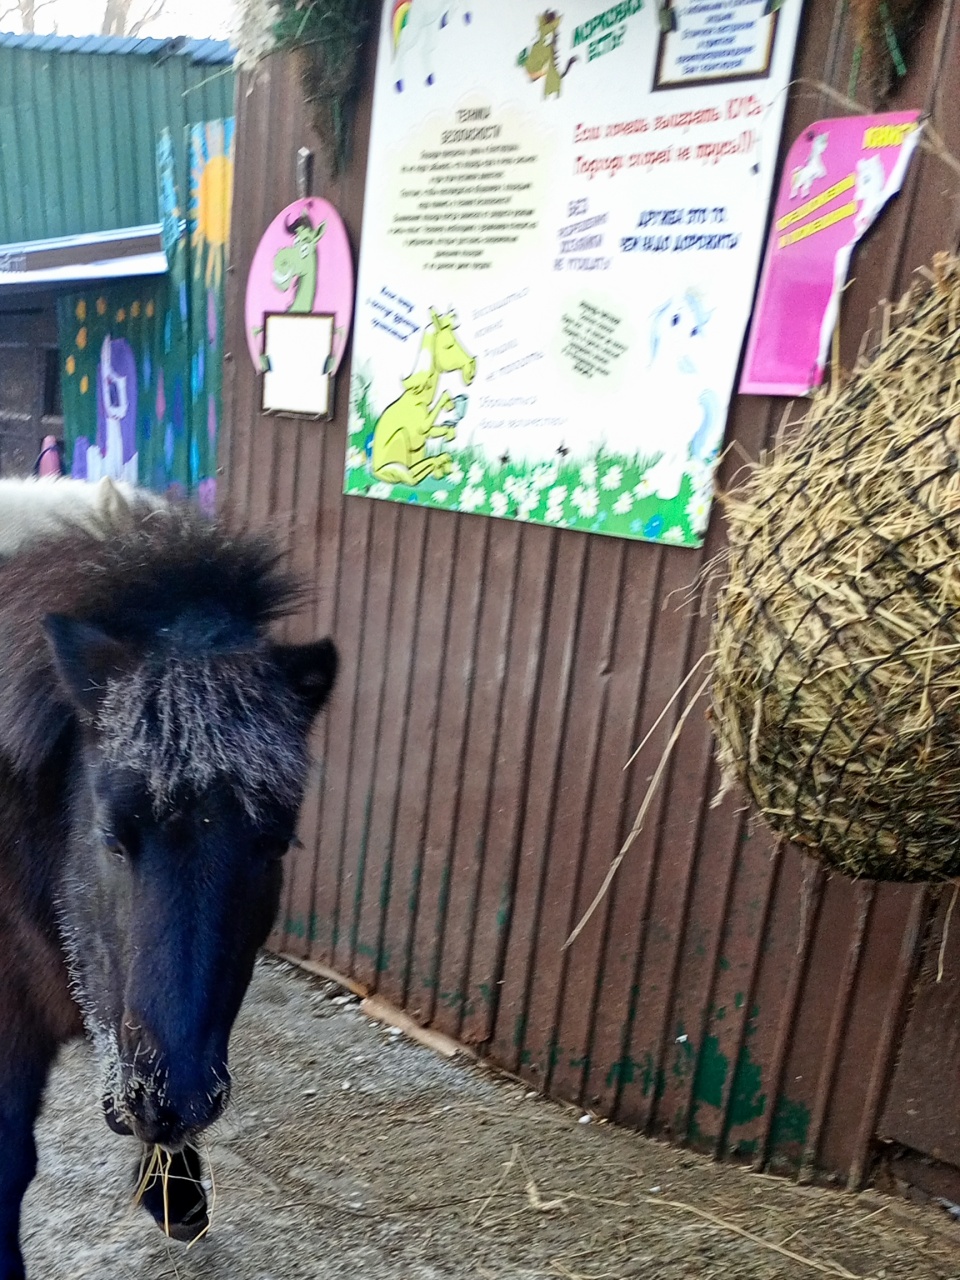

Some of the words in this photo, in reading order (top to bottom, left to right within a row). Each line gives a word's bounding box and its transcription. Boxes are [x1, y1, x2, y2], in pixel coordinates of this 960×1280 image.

[574, 121, 601, 143] Если
[605, 118, 649, 137] хочешь
[654, 107, 721, 133] выиграть
[574, 155, 625, 180] Подходи
[677, 148, 691, 161] не
[636, 208, 685, 229] ДРУЖБА
[686, 207, 708, 225] ЭТО
[642, 234, 671, 253] НАДО
